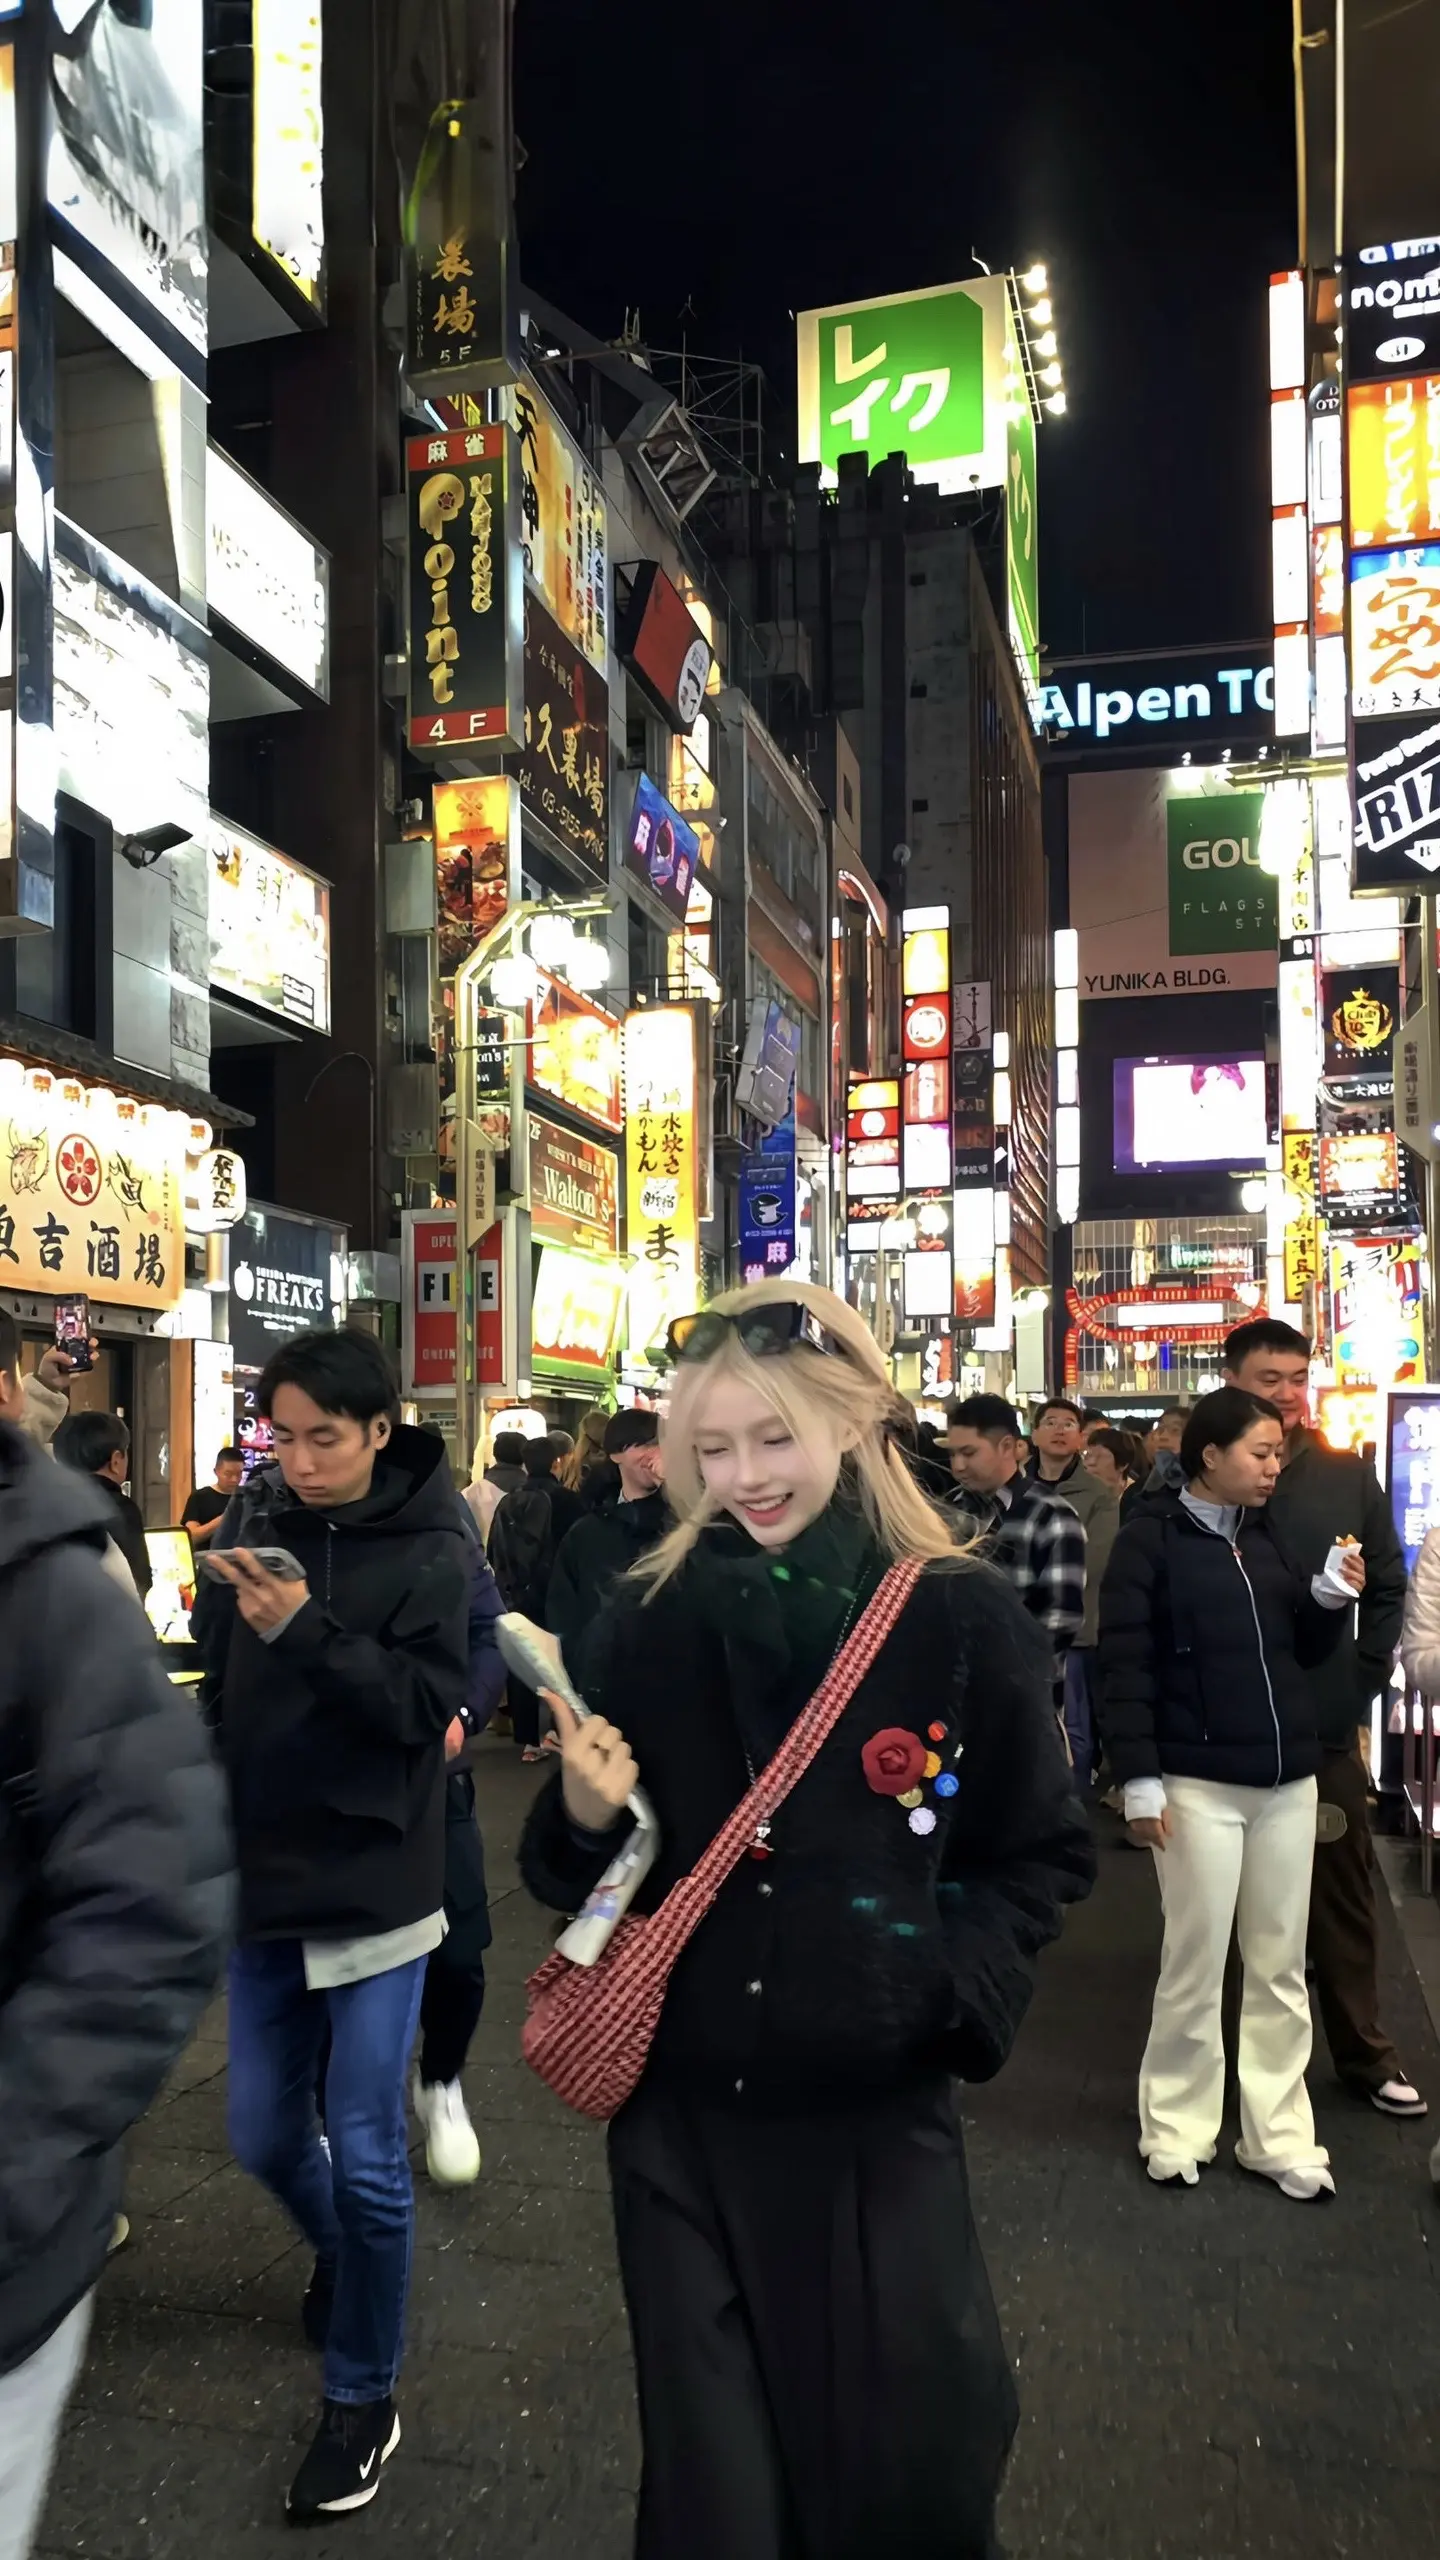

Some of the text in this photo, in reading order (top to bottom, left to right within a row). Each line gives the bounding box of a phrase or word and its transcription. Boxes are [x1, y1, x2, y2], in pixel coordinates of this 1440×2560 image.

[834, 324, 887, 384] レ
[829, 366, 951, 442] イク
[427, 432, 485, 464] 麻雀
[419, 472, 466, 704] Point
[1038, 682, 1211, 737] Alpen
[1235, 916, 1277, 930] ST
[1084, 967, 1231, 993] YUNIKA BLDG.
[1341, 1237, 1404, 1278] キラリ
[256, 1277, 324, 1312] FREAKS
[423, 1271, 494, 1302] FIE
